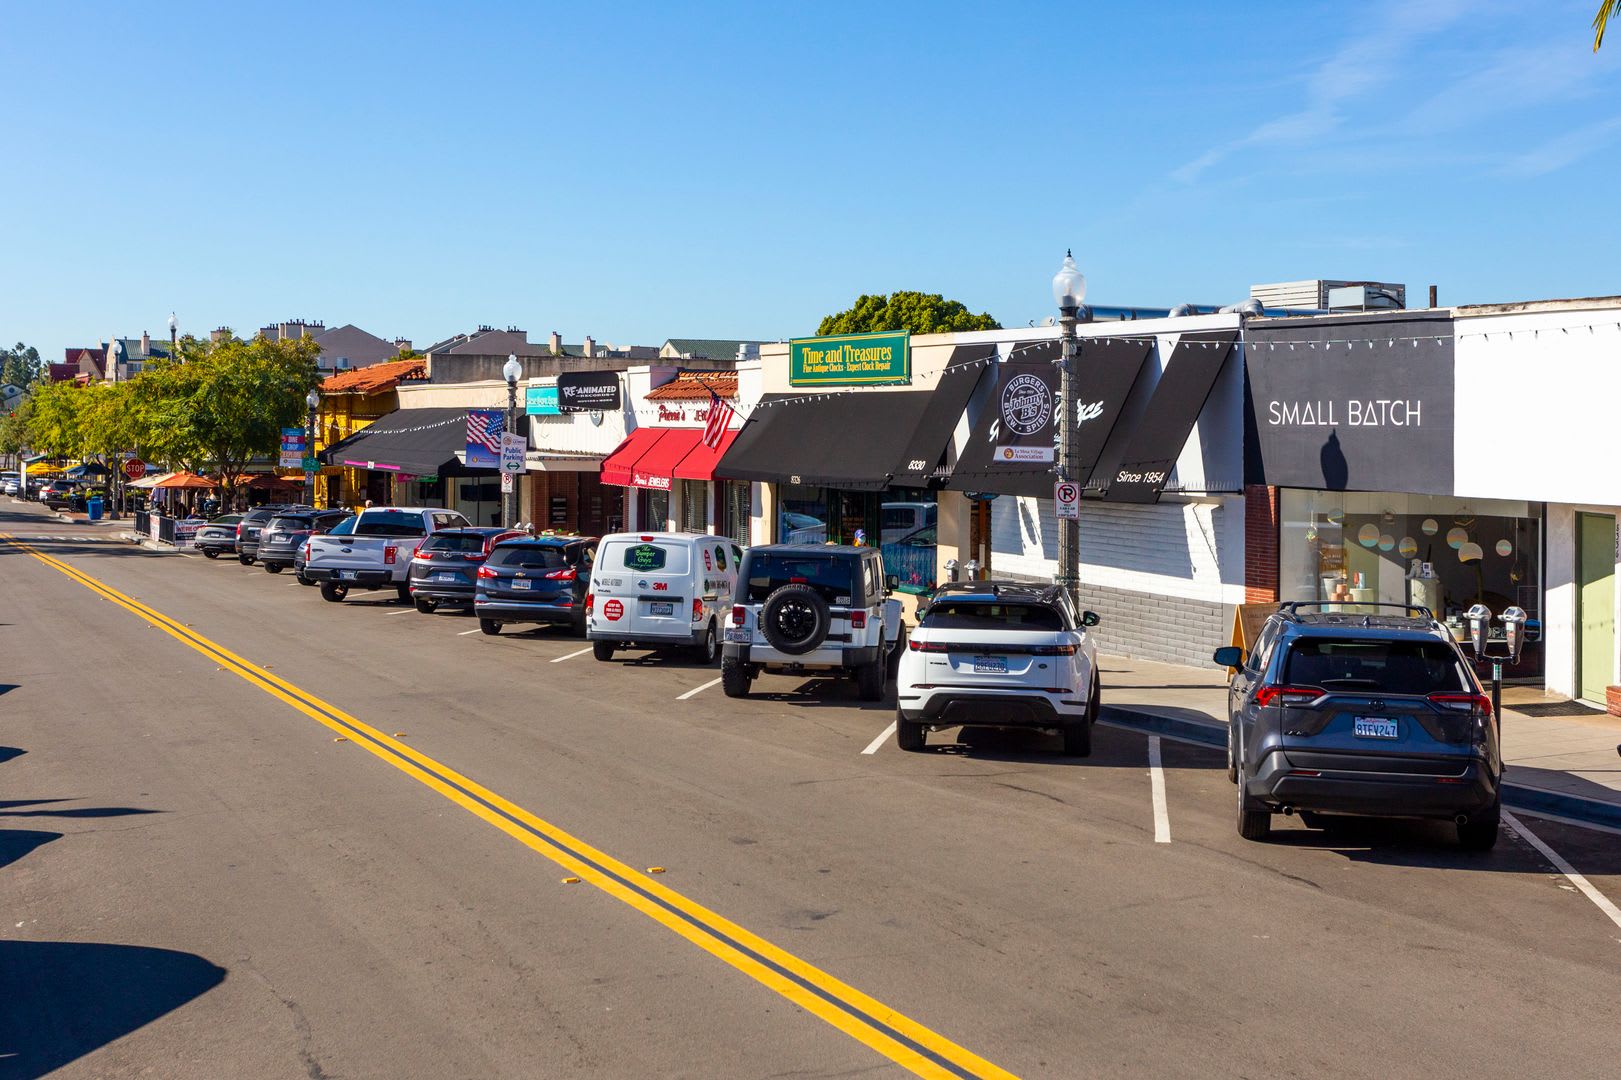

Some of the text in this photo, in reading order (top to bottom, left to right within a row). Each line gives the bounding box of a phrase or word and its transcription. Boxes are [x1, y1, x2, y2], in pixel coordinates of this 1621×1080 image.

[802, 345, 892, 364] Time and Treasures
[803, 364, 812, 373] Fine
[812, 364, 829, 373] Antique
[829, 363, 844, 372] Clocks
[847, 362, 862, 372] Expert
[862, 361, 874, 371] Clock
[875, 361, 891, 371] Repair
[1009, 377, 1045, 392] BURGERS
[562, 385, 616, 398] RE-ANIMATED
[1010, 392, 1044, 411] Johnny
[1004, 402, 1017, 428] BREW
[1026, 403, 1049, 432] SPIRITS
[1021, 405, 1037, 419] B's
[1268, 400, 1421, 426] SMALL BATCH
[503, 454, 523, 462] Parking
[908, 460, 926, 470] 8330
[648, 476, 670, 488] JEWELERS
[1116, 471, 1165, 483] Since 1954
[636, 550, 656, 558] Bumper
[652, 582, 668, 591] 3M
[1356, 724, 1398, 736] 8TFV247
